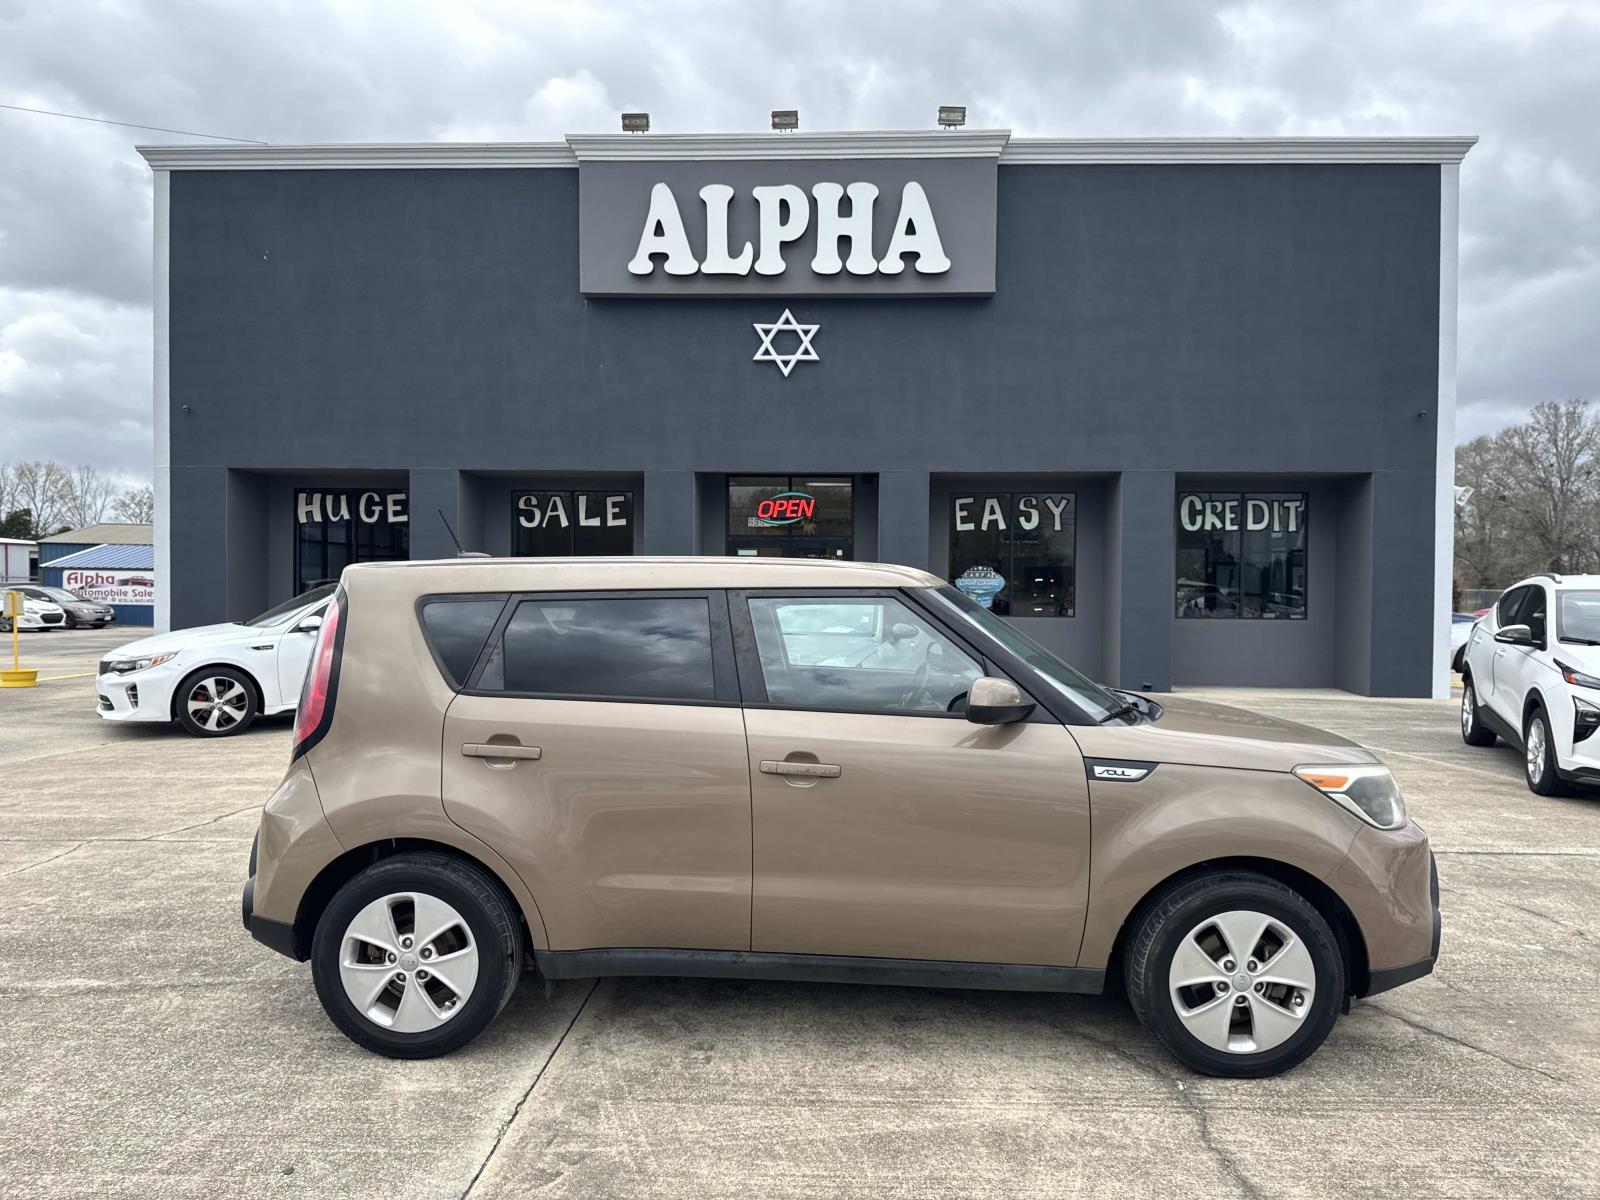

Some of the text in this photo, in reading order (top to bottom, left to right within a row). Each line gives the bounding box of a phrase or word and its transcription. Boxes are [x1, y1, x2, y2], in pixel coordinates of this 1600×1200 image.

[628, 181, 951, 275] ALPHA
[298, 492, 408, 523] HUGE
[519, 495, 627, 528] SALE
[757, 497, 815, 518] OPEN
[955, 497, 1069, 531] EASY
[1180, 495, 1301, 531] CREDIT
[67, 572, 114, 586] Alpha
